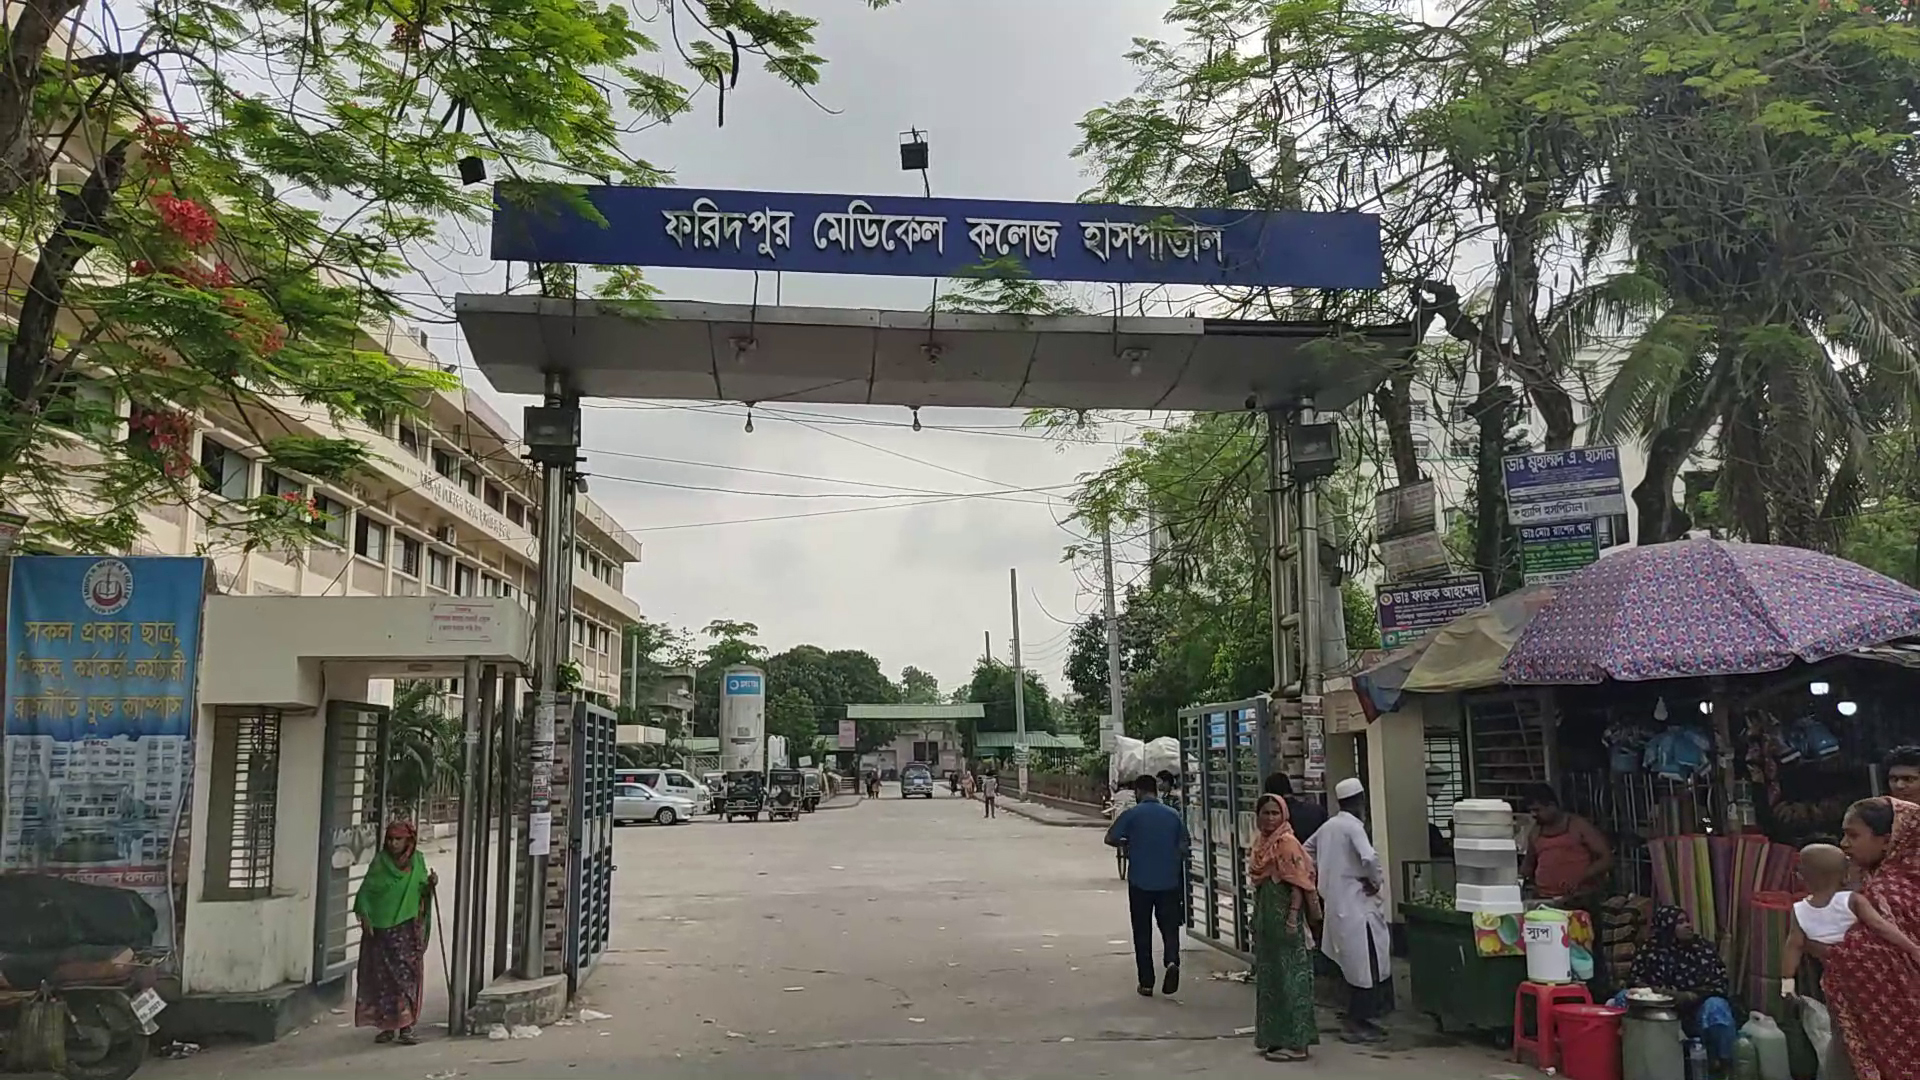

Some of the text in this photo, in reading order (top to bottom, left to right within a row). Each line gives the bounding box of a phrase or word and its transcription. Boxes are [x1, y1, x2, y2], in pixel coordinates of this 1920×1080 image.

[661, 197, 1226, 263] ফরিদপুর মেডিকেল কলেজ হাসপাতাল
[1506, 458, 1524, 471] ডাঃ
[1585, 447, 1616, 463] হাসান
[1544, 501, 1583, 515] হসপিটাল
[1393, 592, 1409, 604] ডাঃ
[1410, 588, 1440, 602] ফারুক
[25, 621, 180, 649] সকল প্রকার ছাত্র,
[1526, 927, 1550, 941] স্যুপ
